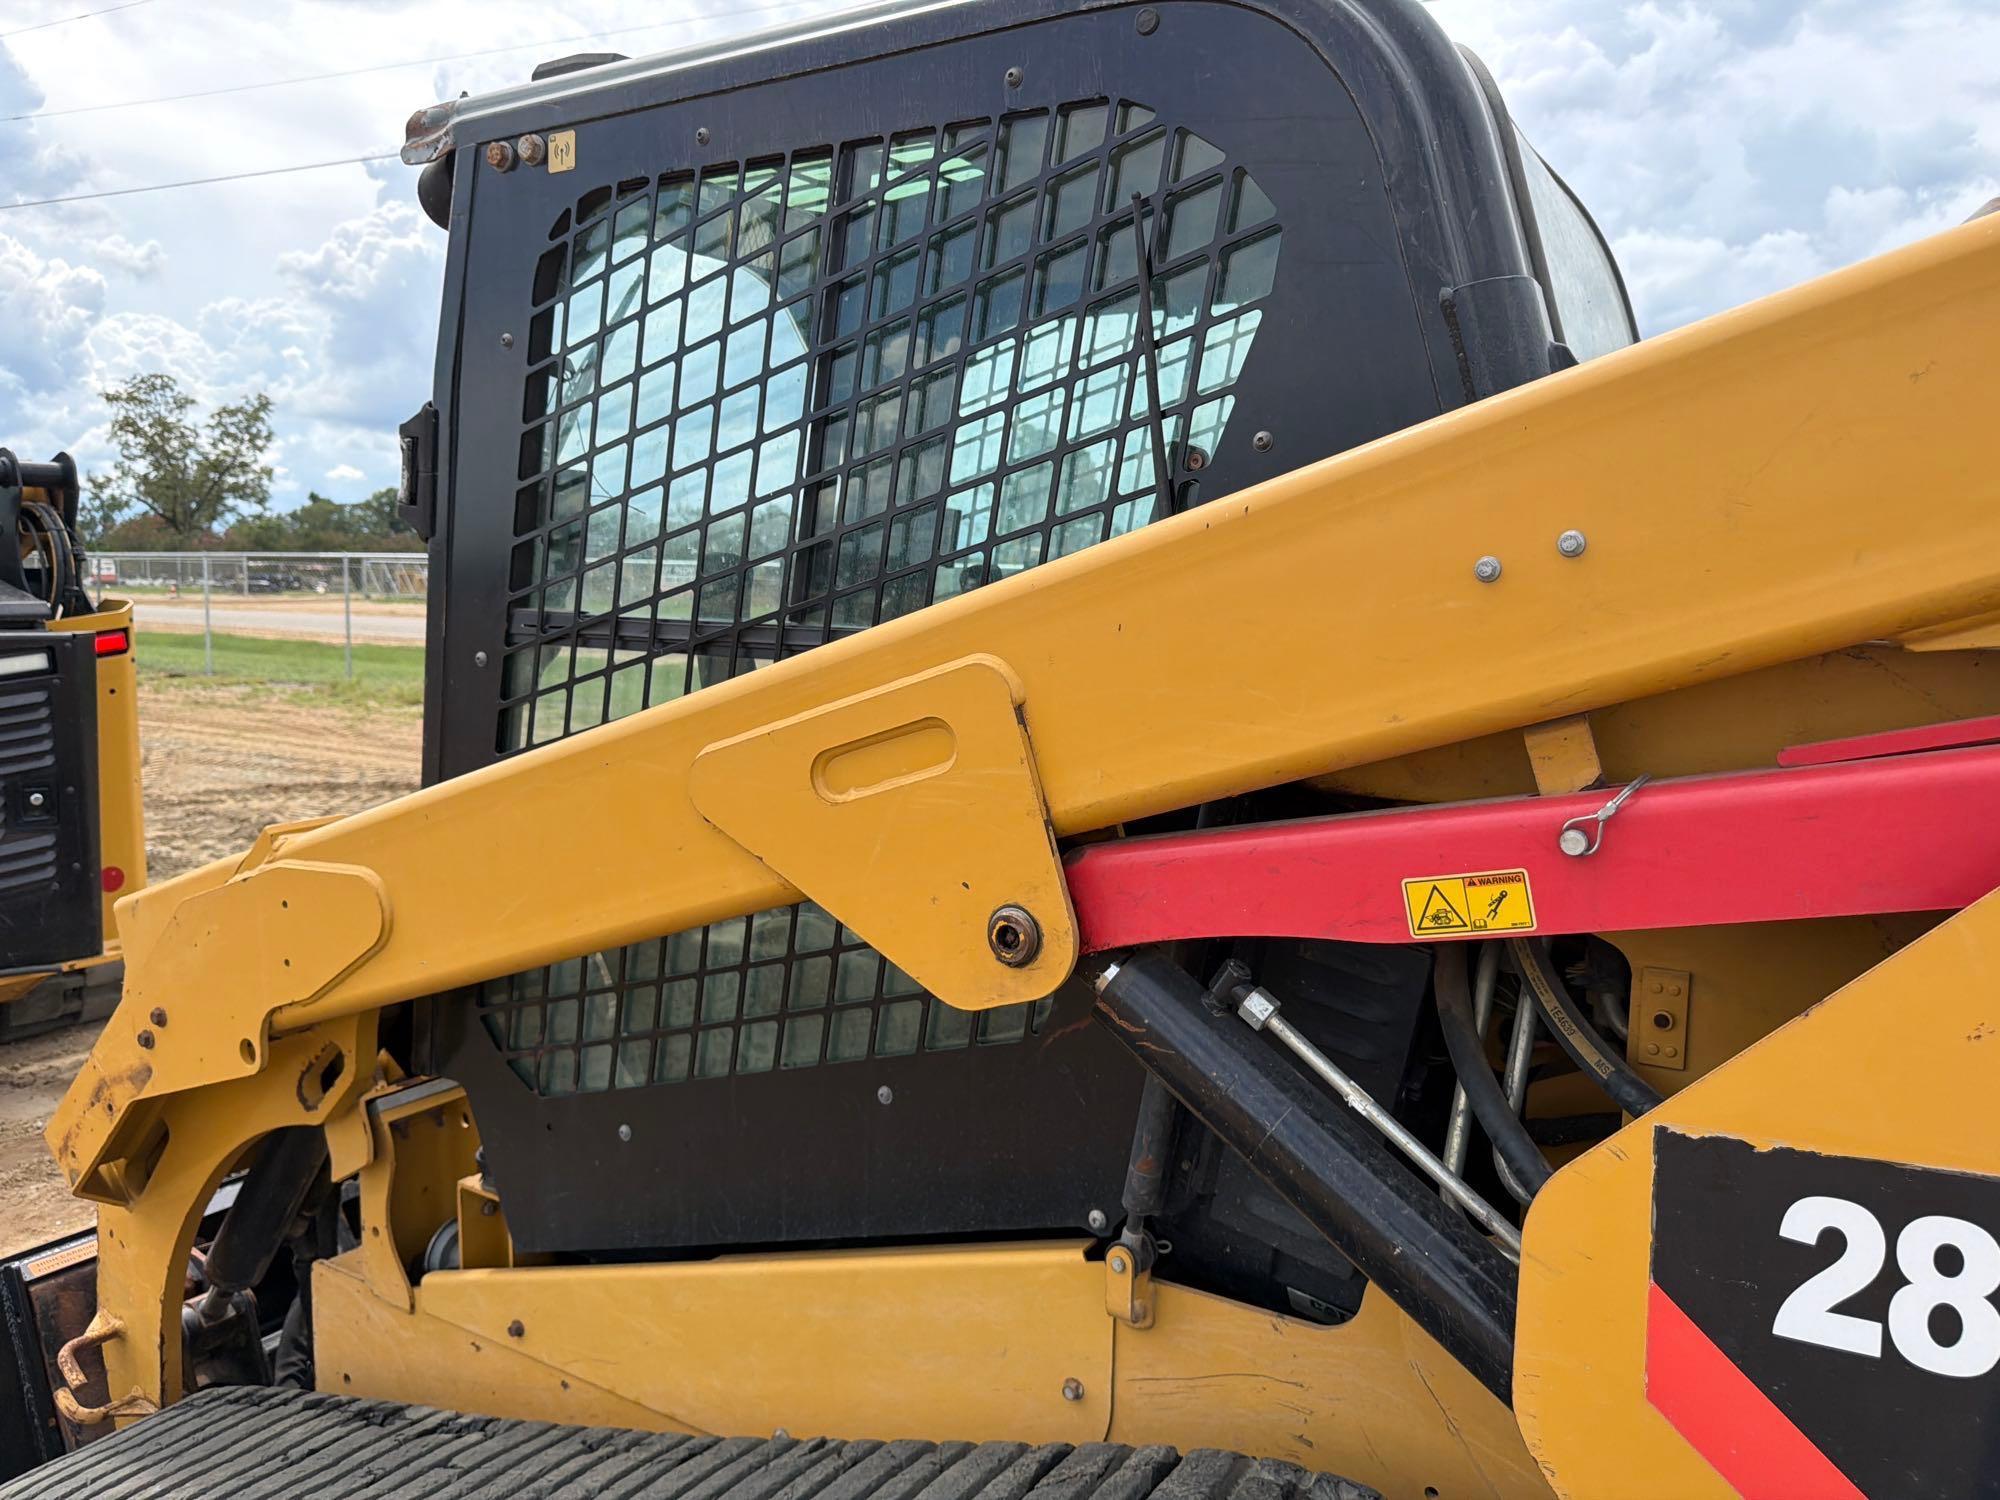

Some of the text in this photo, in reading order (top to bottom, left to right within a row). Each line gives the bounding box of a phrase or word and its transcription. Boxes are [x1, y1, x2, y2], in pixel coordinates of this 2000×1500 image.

[1478, 874, 1522, 886] WARNING
[1550, 1005, 1576, 1037] 1E4639
[1772, 1196, 2000, 1378] 28
